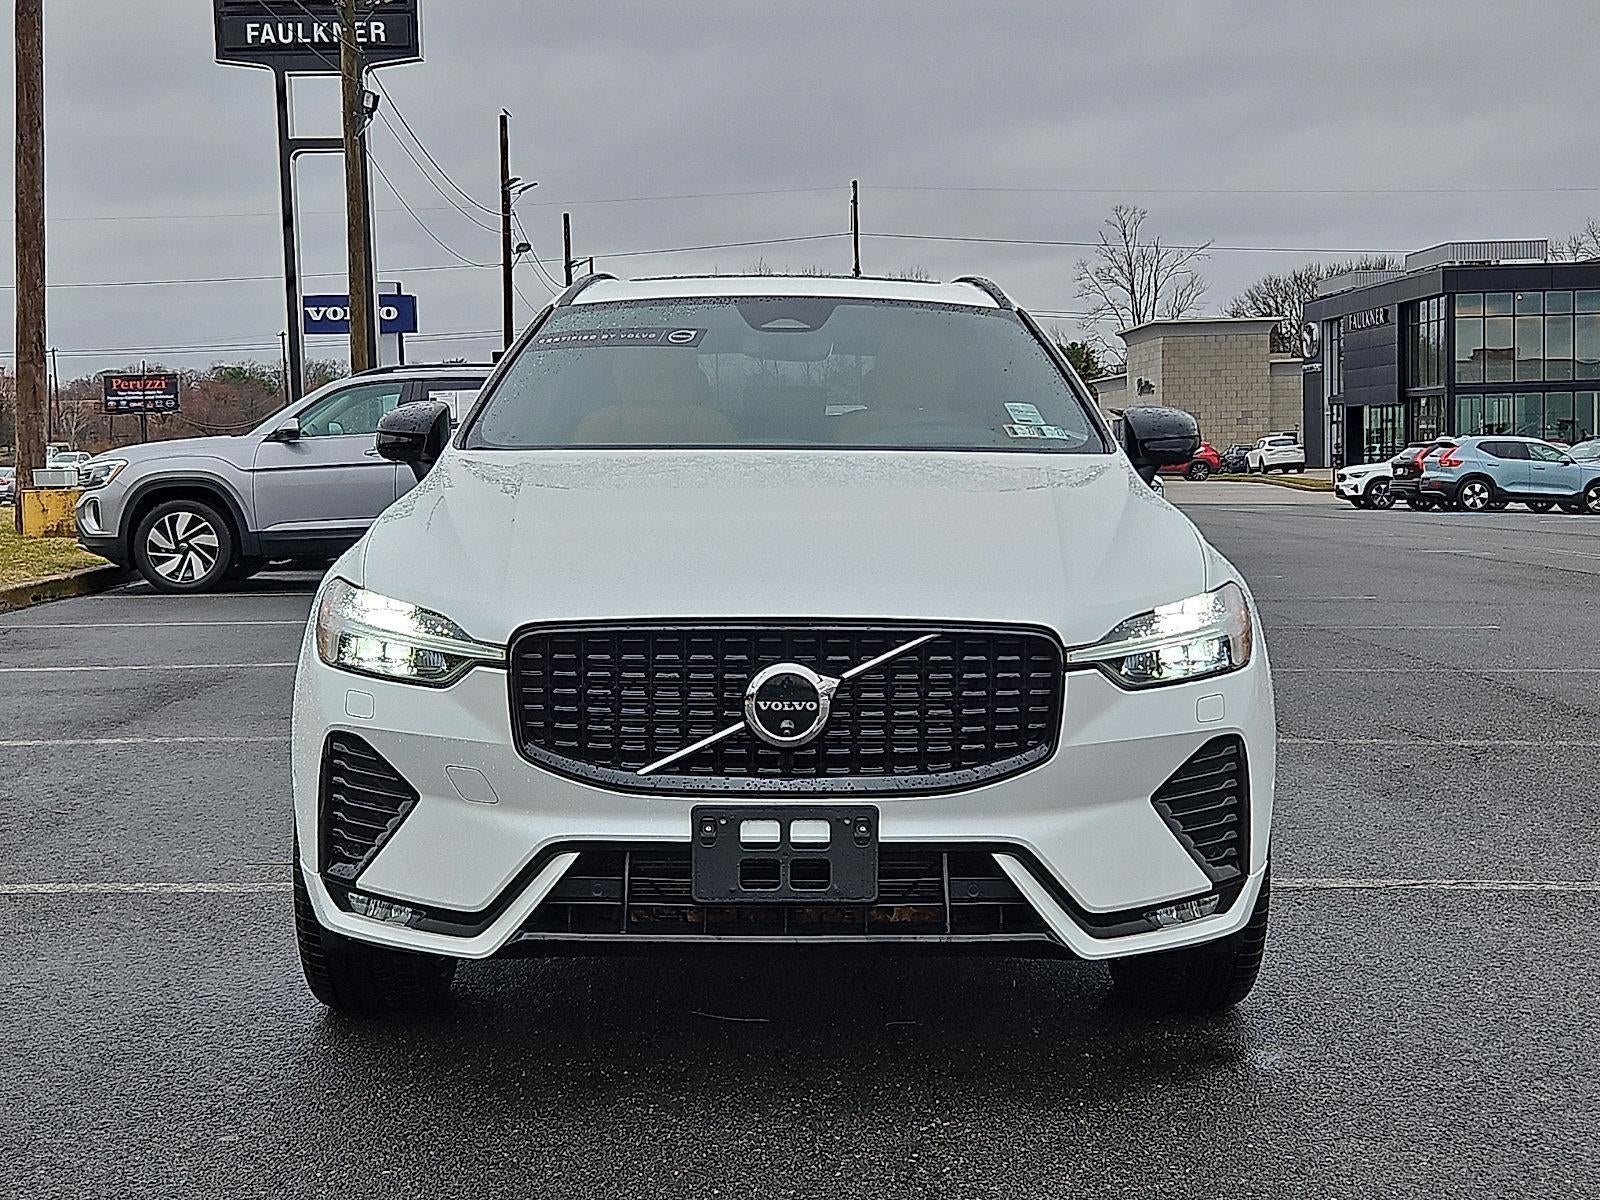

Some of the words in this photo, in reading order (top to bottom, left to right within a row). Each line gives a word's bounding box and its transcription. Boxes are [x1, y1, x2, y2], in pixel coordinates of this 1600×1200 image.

[1348, 307, 1385, 331] FAULKNER
[620, 331, 656, 340] VOLVO
[111, 376, 167, 390] Peruzzi
[757, 701, 818, 711] VOLVO
